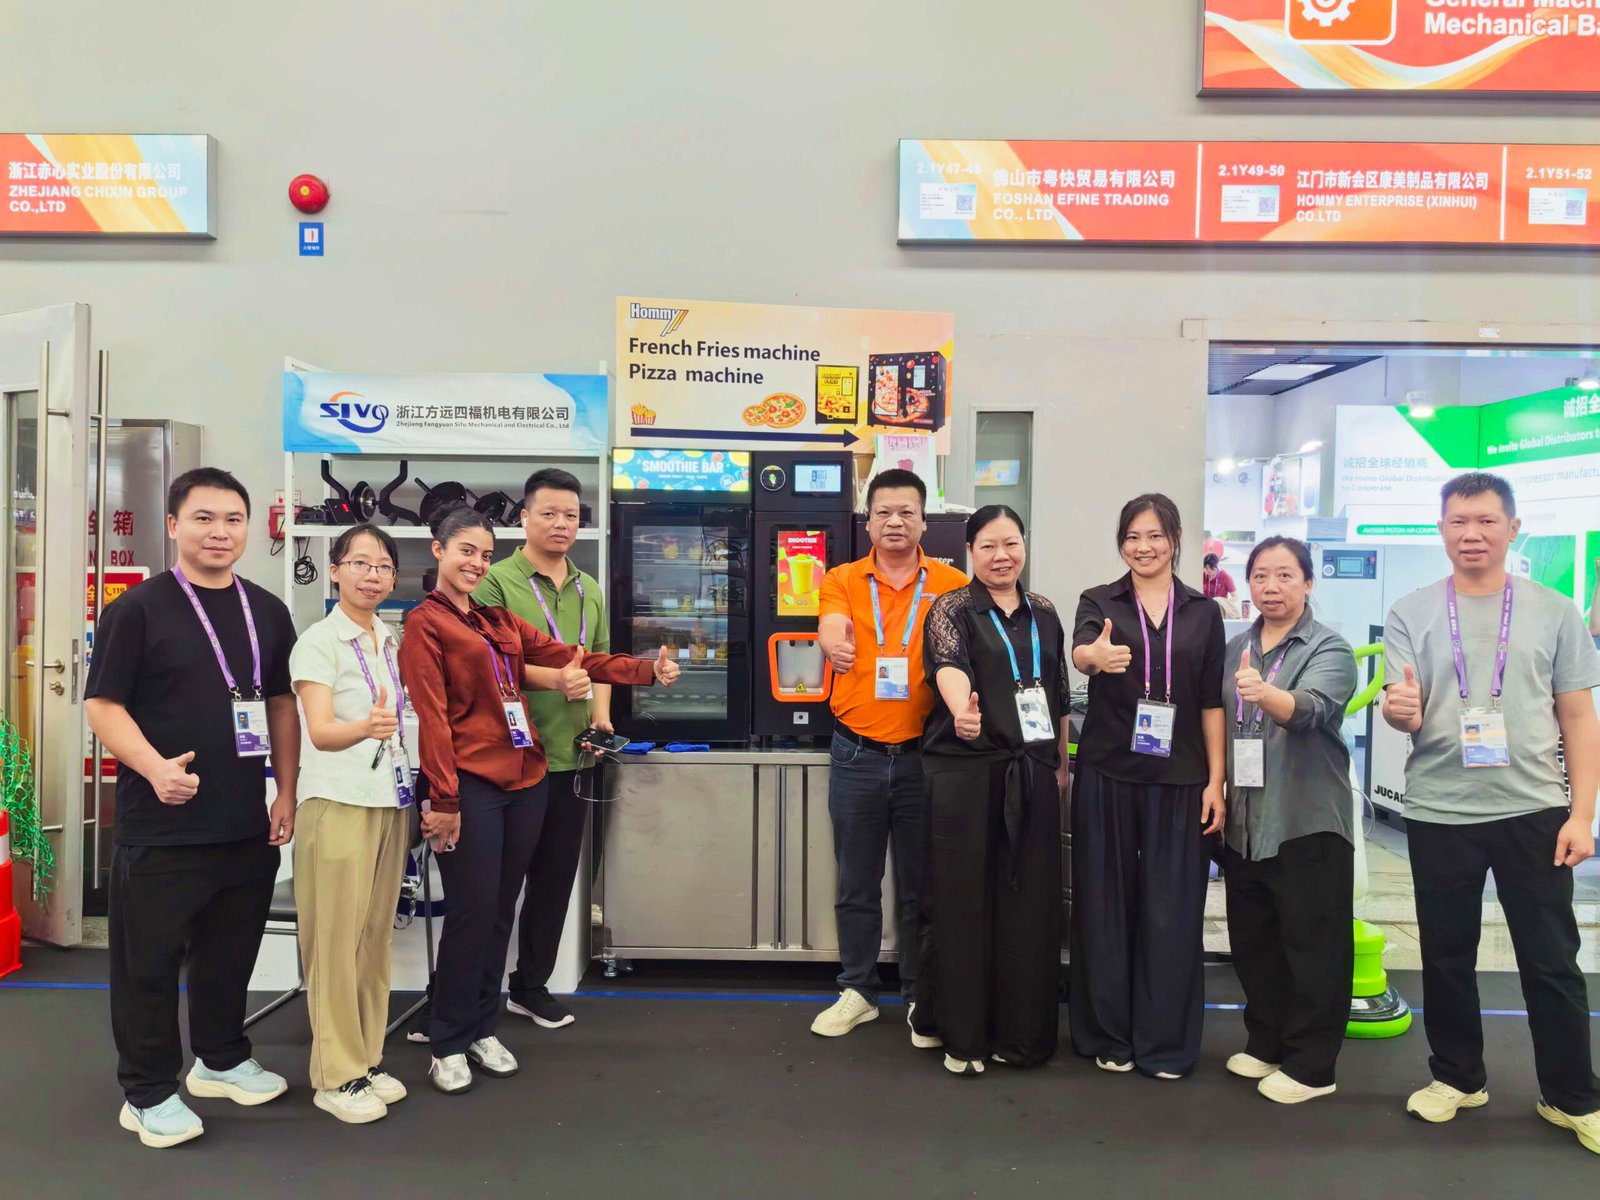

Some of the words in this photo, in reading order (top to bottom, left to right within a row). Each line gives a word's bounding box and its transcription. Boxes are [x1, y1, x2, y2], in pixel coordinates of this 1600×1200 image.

[1425, 12, 1569, 35] Mechanical
[1578, 14, 1600, 36] B
[9, 162, 181, 180] 浙江赤心实业股份有限公司
[1218, 164, 1285, 176] 2.1Y49-50
[1526, 167, 1592, 179] 2.1Y51-52
[993, 169, 1175, 188] 佛山市粤快贸易有限公司
[1296, 170, 1489, 190] 江门市新会区康美制品有限公司
[9, 185, 81, 197] ZHEJIANG
[85, 186, 133, 198] CHIXIN
[136, 186, 188, 198] GROUP
[9, 201, 66, 213] CO.,LTD
[993, 193, 1053, 205] FOSHAN
[1057, 193, 1100, 206] EFINE
[1103, 194, 1169, 206] TRADING
[1297, 195, 1345, 207] HOMMY
[1348, 195, 1424, 208] ENTERPRISE
[1426, 196, 1477, 209] (XINHUI)
[1027, 209, 1053, 221] LTD
[629, 338, 692, 355] French
[697, 341, 740, 358] Fries
[744, 343, 820, 361] machine
[629, 364, 677, 381] Pizza
[686, 366, 764, 384] machine
[396, 405, 569, 421] 浙江方远四福机电有限公司
[424, 421, 454, 429] Fangyuan
[1487, 445, 1497, 455] We
[1498, 442, 1518, 453] Invite
[1520, 437, 1543, 450] Global
[1544, 430, 1593, 446] Distributors
[642, 460, 699, 473] SMOOTHIE
[701, 461, 724, 473] BAR
[110, 550, 134, 566] BOX
